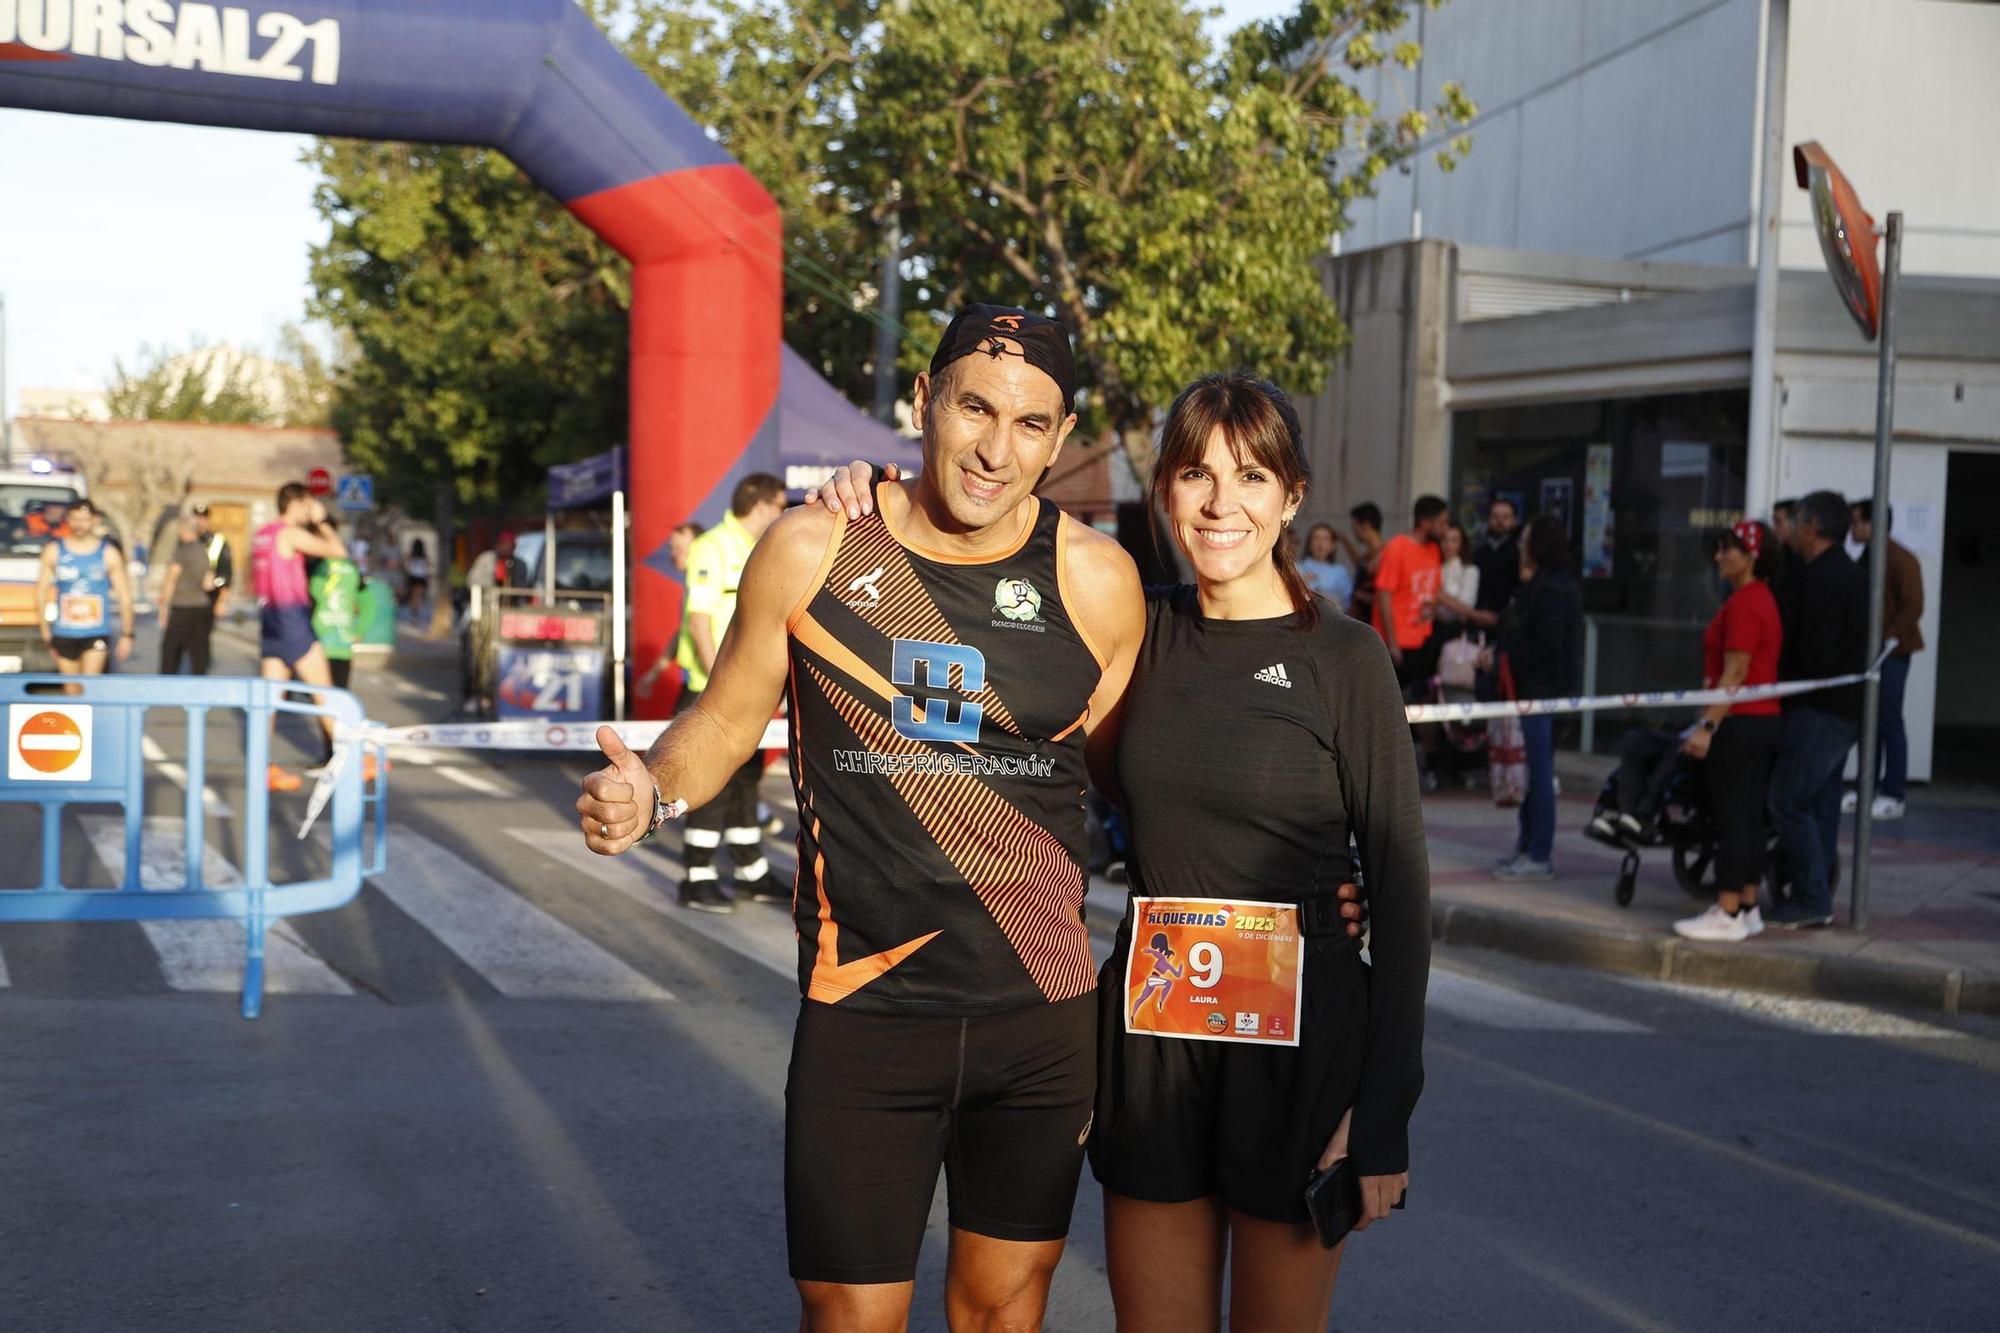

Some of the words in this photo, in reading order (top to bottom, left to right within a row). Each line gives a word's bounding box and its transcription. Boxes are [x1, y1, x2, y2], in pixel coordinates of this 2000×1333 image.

[1253, 672, 1292, 688] adidas
[531, 670, 584, 712] 21
[1148, 911, 1228, 927] ALQUERIAS
[1234, 915, 1276, 932] 2023
[1244, 932, 1254, 940] DE
[1255, 933, 1294, 943] DICIEMBRE
[1187, 940, 1224, 990] 9
[1189, 995, 1218, 1004] LAURA
